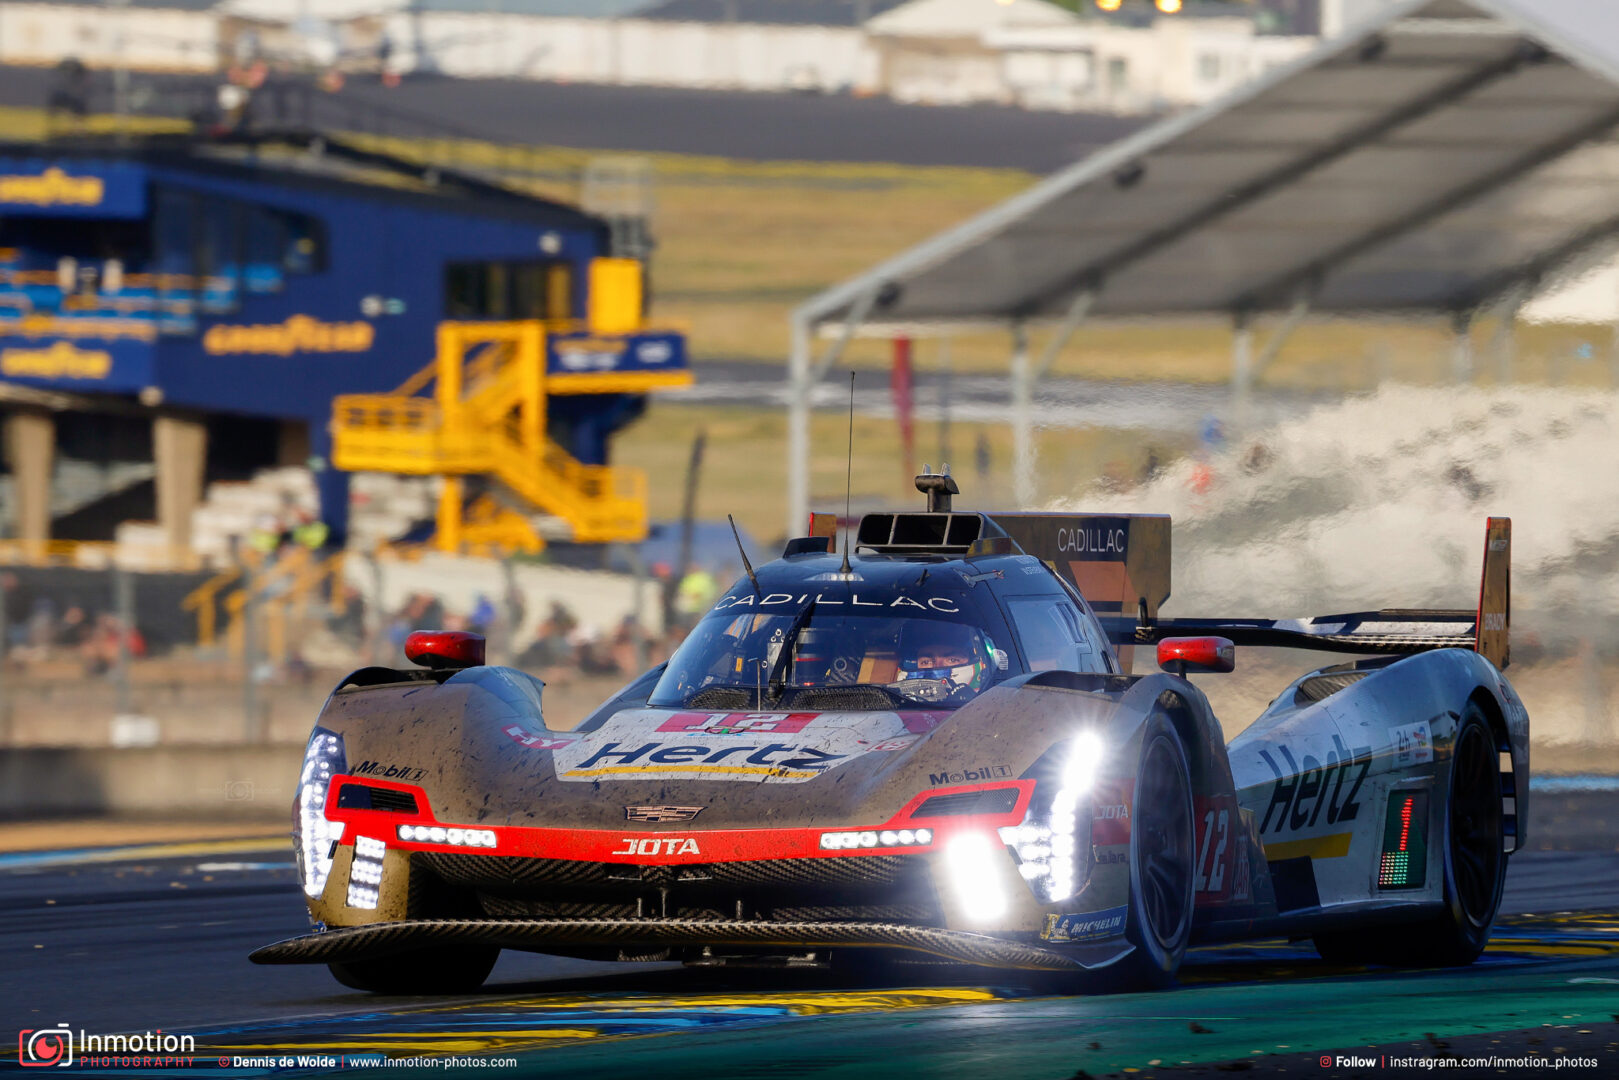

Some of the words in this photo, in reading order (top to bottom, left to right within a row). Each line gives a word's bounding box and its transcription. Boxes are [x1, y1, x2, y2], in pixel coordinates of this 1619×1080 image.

[1057, 527, 1124, 552] CADILLAC
[714, 593, 959, 612] CADILLAC
[683, 713, 791, 731] 12
[576, 743, 848, 770] Hertz
[356, 760, 411, 779] Mobil
[929, 767, 991, 785] Mobil
[1258, 734, 1373, 834] Hertz
[1094, 804, 1129, 819] JOTA
[612, 838, 700, 855] JOTA
[1195, 809, 1230, 892] 12
[1071, 916, 1122, 934] MICHELIN
